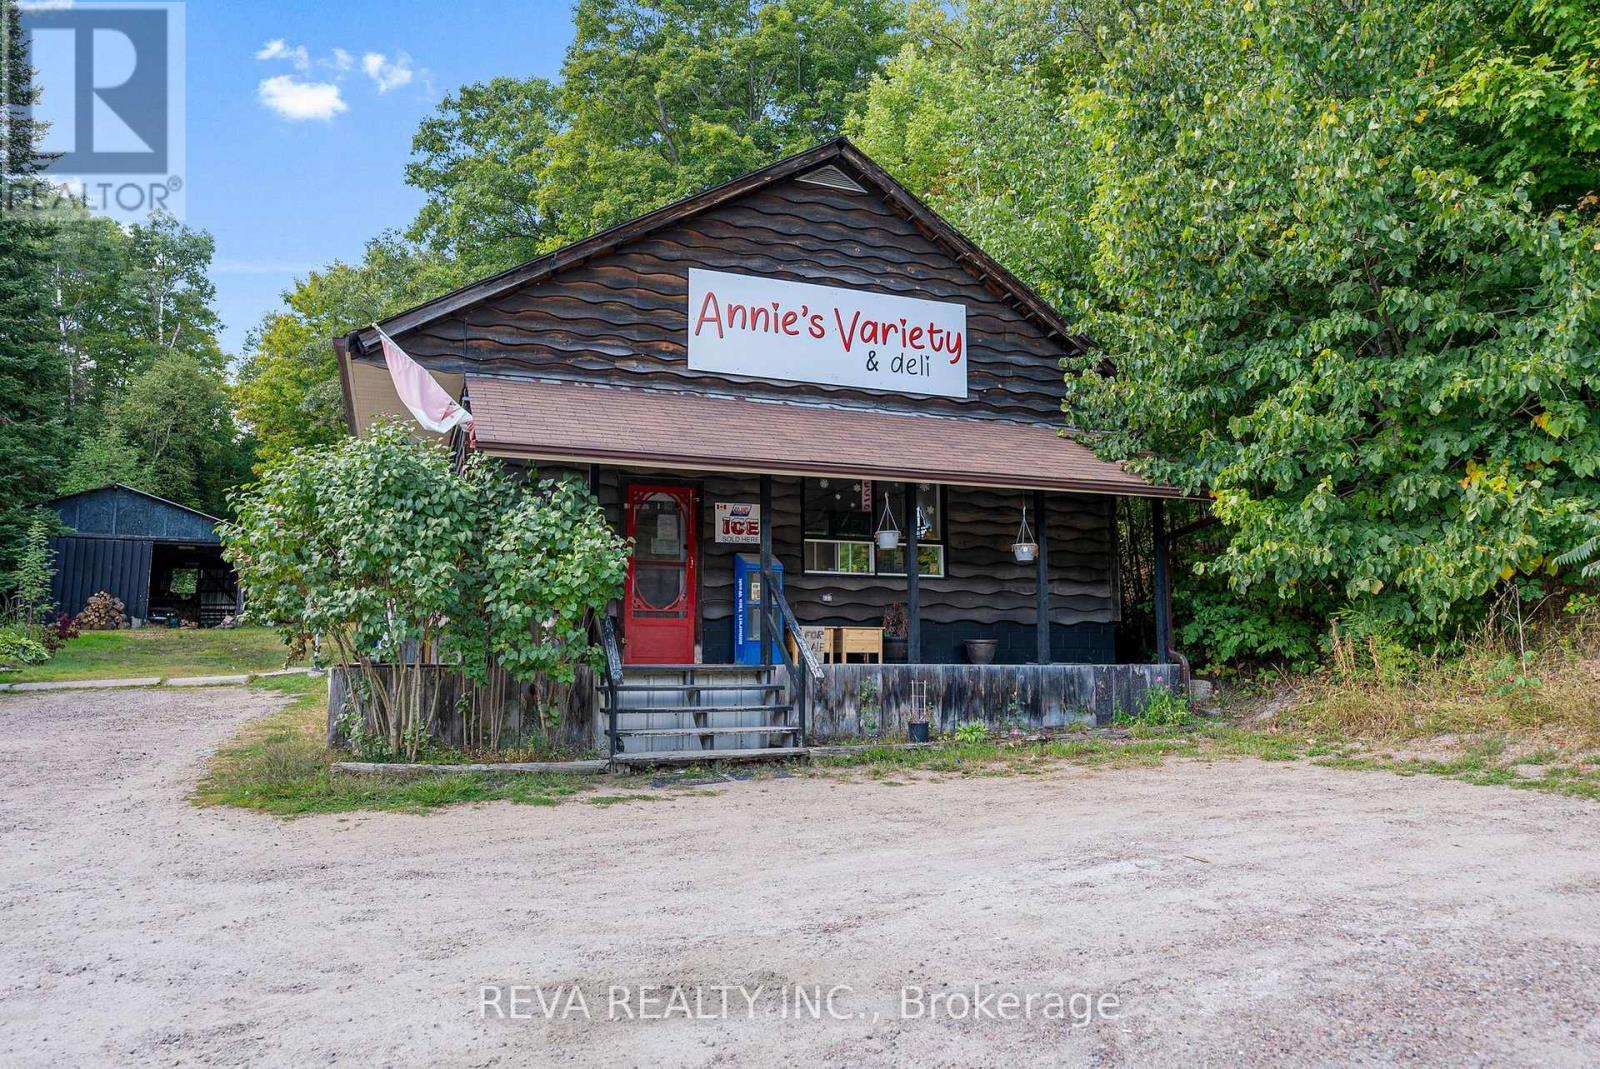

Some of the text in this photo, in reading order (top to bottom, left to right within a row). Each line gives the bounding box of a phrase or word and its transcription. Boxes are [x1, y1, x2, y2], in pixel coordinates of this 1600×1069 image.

[695, 291, 962, 364] Annie's Variety
[866, 350, 930, 377] & deli
[722, 517, 760, 536] ICE
[804, 630, 824, 640] FOR
